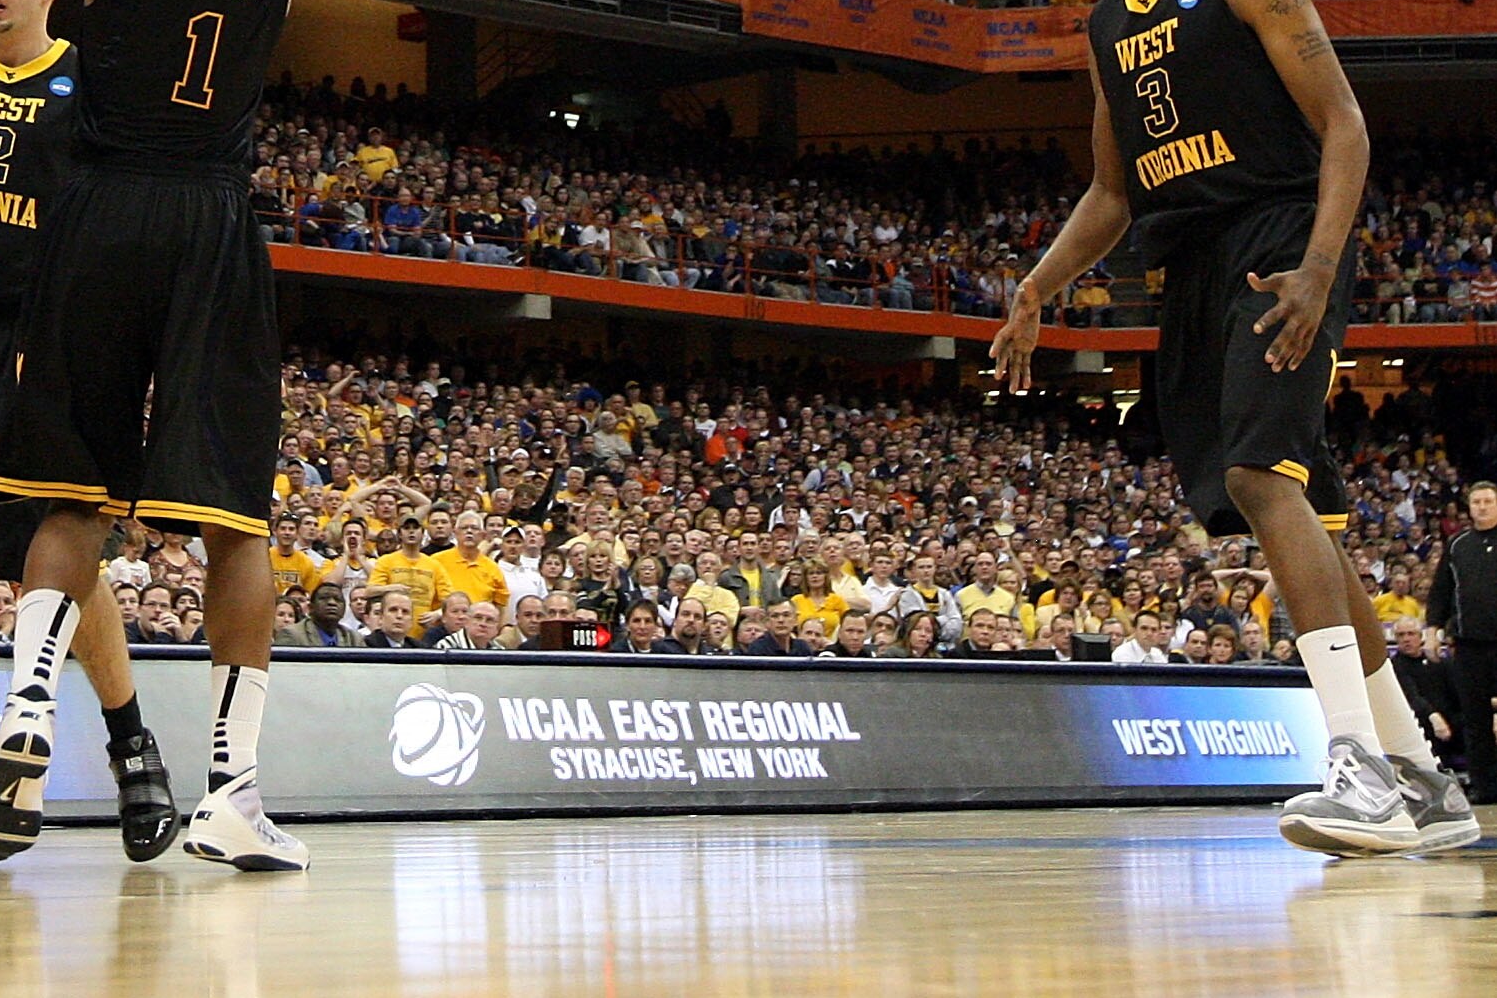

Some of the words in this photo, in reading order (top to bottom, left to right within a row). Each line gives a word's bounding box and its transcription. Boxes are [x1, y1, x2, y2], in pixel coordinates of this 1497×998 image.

[986, 21, 1038, 36] NCAA
[1114, 17, 1178, 74] WEST
[170, 10, 224, 110] 1
[1135, 67, 1179, 139] 3
[1135, 130, 1236, 191] VIRGINIA
[498, 696, 605, 740] NCAA
[608, 699, 694, 741] EAST
[698, 699, 861, 741] REGIONAL
[1112, 718, 1187, 755] WEST
[1184, 719, 1297, 755] VIRGINIA
[549, 747, 697, 785] SYRACUSE,
[695, 747, 754, 779] NEW
[757, 747, 828, 778] YORK
